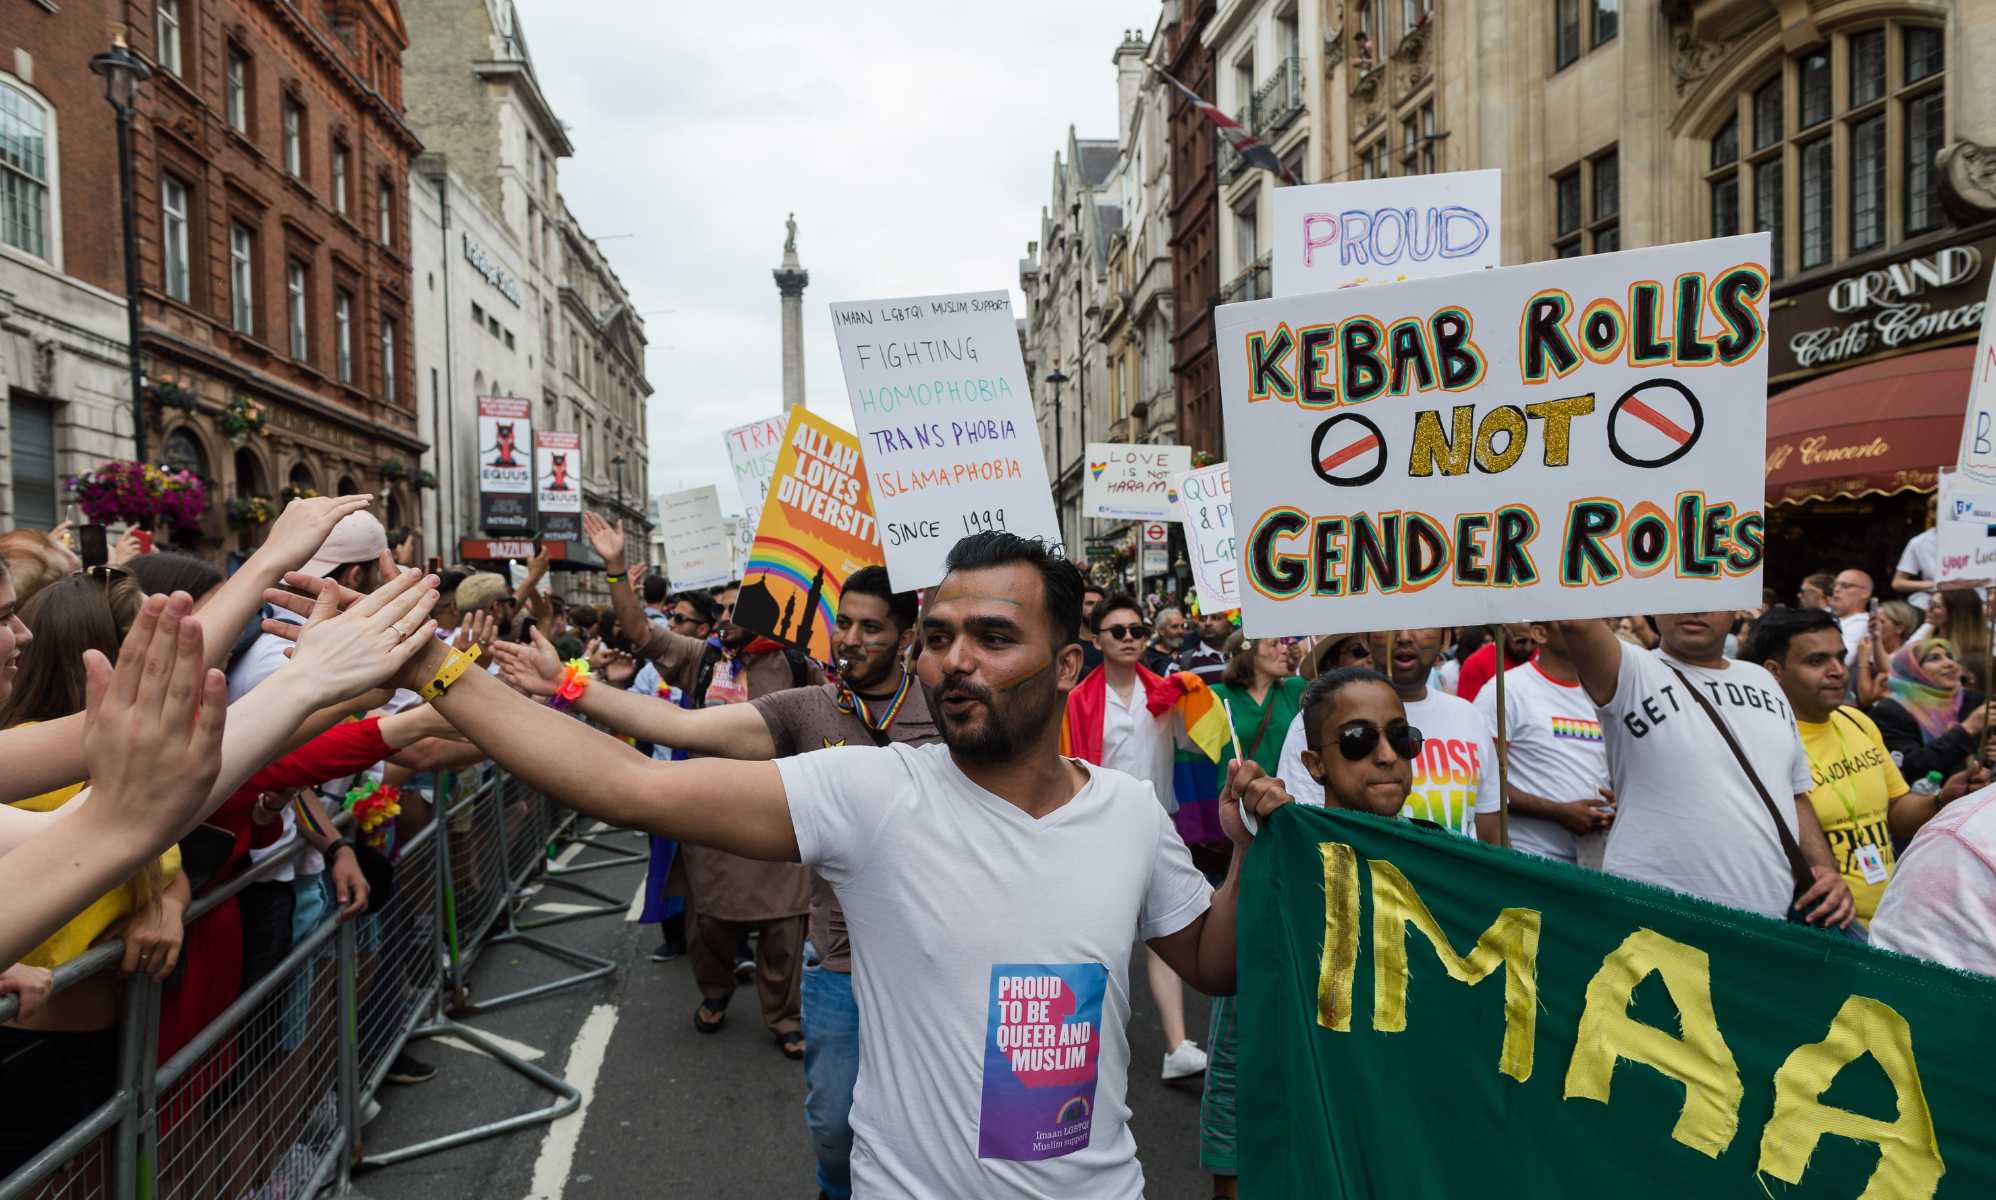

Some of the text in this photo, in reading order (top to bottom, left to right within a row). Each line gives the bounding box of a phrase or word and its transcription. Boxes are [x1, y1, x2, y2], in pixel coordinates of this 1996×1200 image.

[1302, 206, 1489, 267] PROUD
[1829, 246, 1983, 313] GRAND
[881, 305, 923, 322] LGBTQI
[931, 300, 968, 316] MUSLIM
[972, 298, 1009, 312] SUPPORT
[1246, 262, 1770, 410] KEBAB ROLLS
[856, 336, 978, 370] FIGHTING
[858, 376, 1013, 414] HOMOPHOBIA
[792, 422, 859, 476] ALLAH
[1408, 392, 1595, 478] NOT
[482, 470, 528, 481] EQUUS
[1110, 452, 1169, 467] LOVE
[1123, 467, 1169, 479] IS NOT
[795, 451, 861, 506] LOVES
[1107, 480, 1167, 493] HARAM
[540, 493, 578, 502] EQUUS
[888, 508, 1006, 546] SINCE 1999
[1245, 491, 1764, 600] GENDER ROLES
[1624, 686, 1680, 738] GET
[998, 976, 1061, 999] PROUD
[998, 1001, 1050, 1024] TO BE
[1316, 842, 1945, 1200] IMAA
[996, 1021, 1091, 1052] QUEER AND
[1011, 1045, 1086, 1072] MUSLIM
[1033, 1140, 1063, 1151] Muslim
[1035, 1130, 1063, 1140] Imaan
